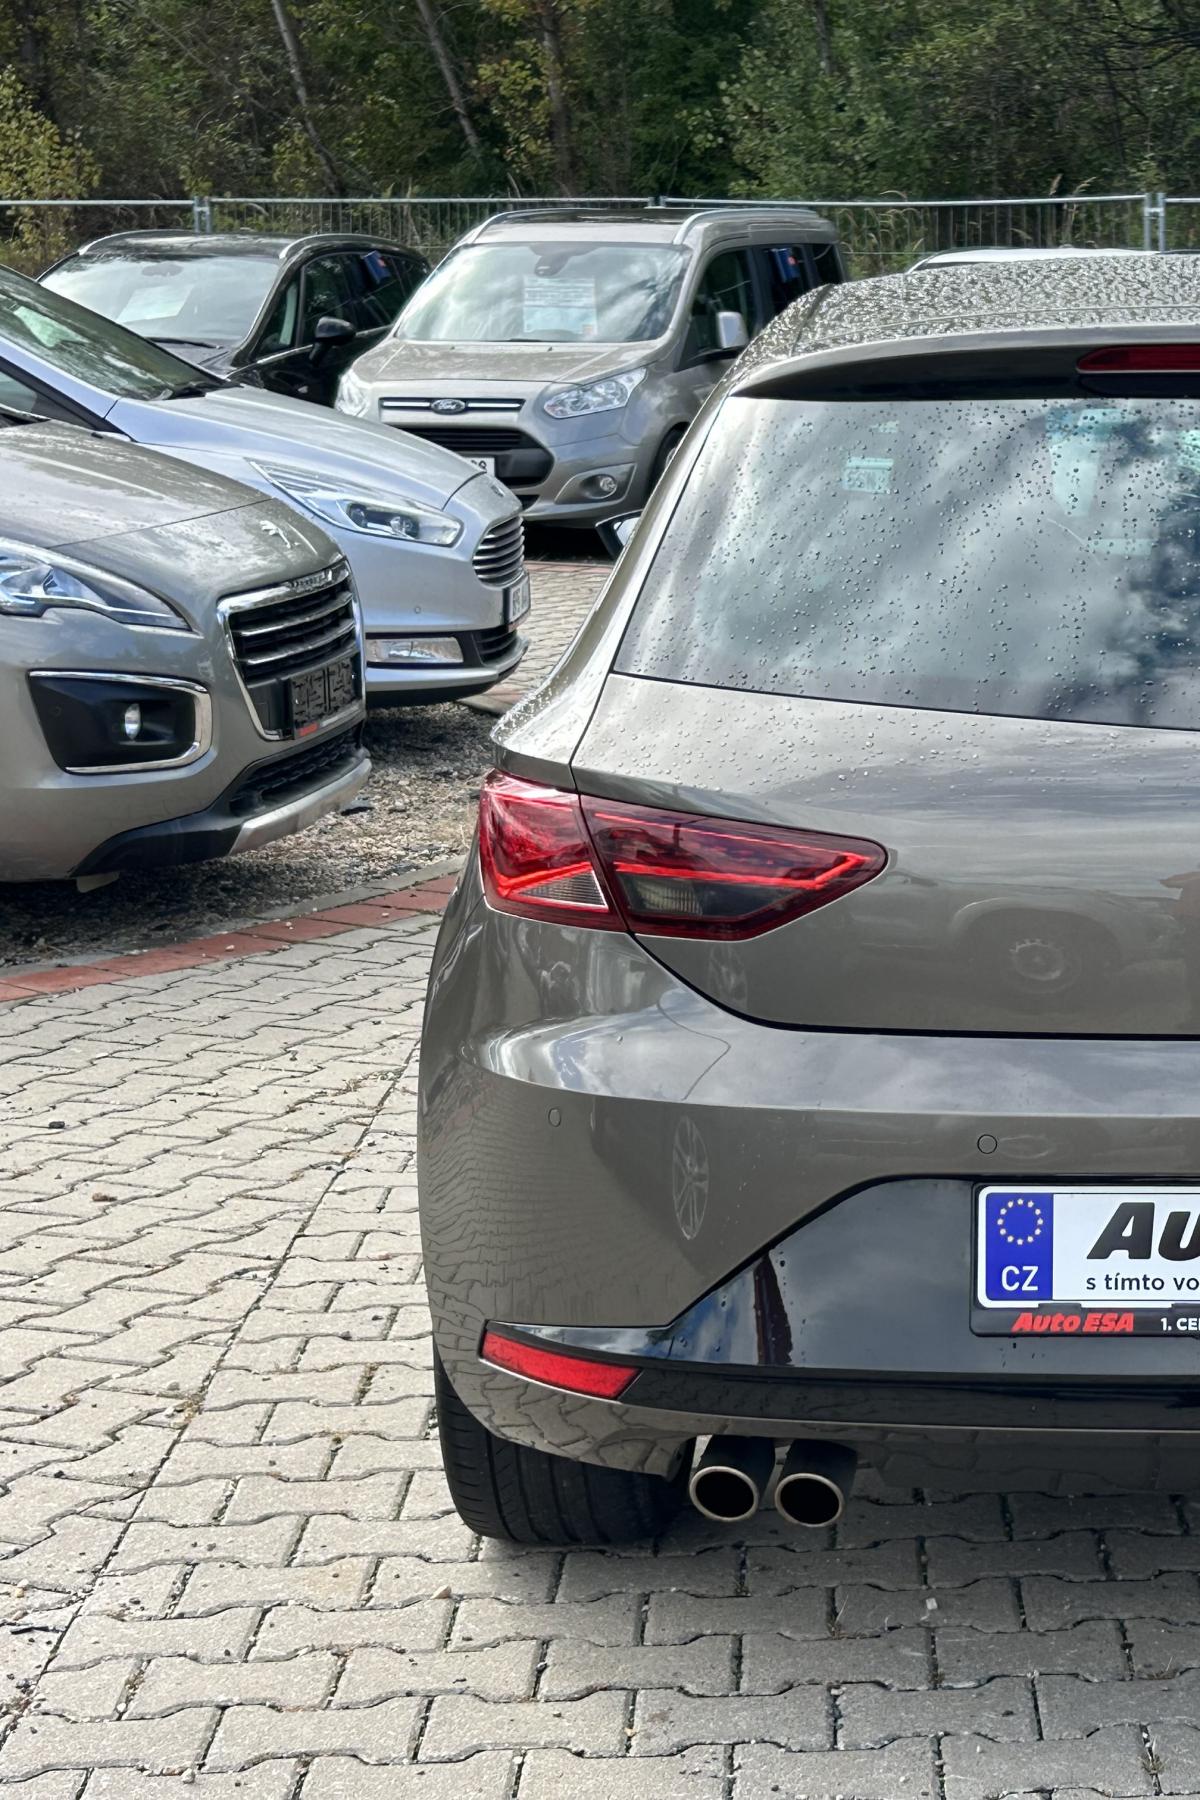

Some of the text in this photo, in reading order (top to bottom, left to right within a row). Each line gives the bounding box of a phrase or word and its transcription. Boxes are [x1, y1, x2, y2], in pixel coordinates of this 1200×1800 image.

[1001, 1265, 1039, 1292] CZ
[1086, 1277, 1097, 1291] s
[1104, 1272, 1166, 1291] tímto
[1010, 1312, 1135, 1333] Auto ESA
[1160, 1317, 1173, 1331] 1.
